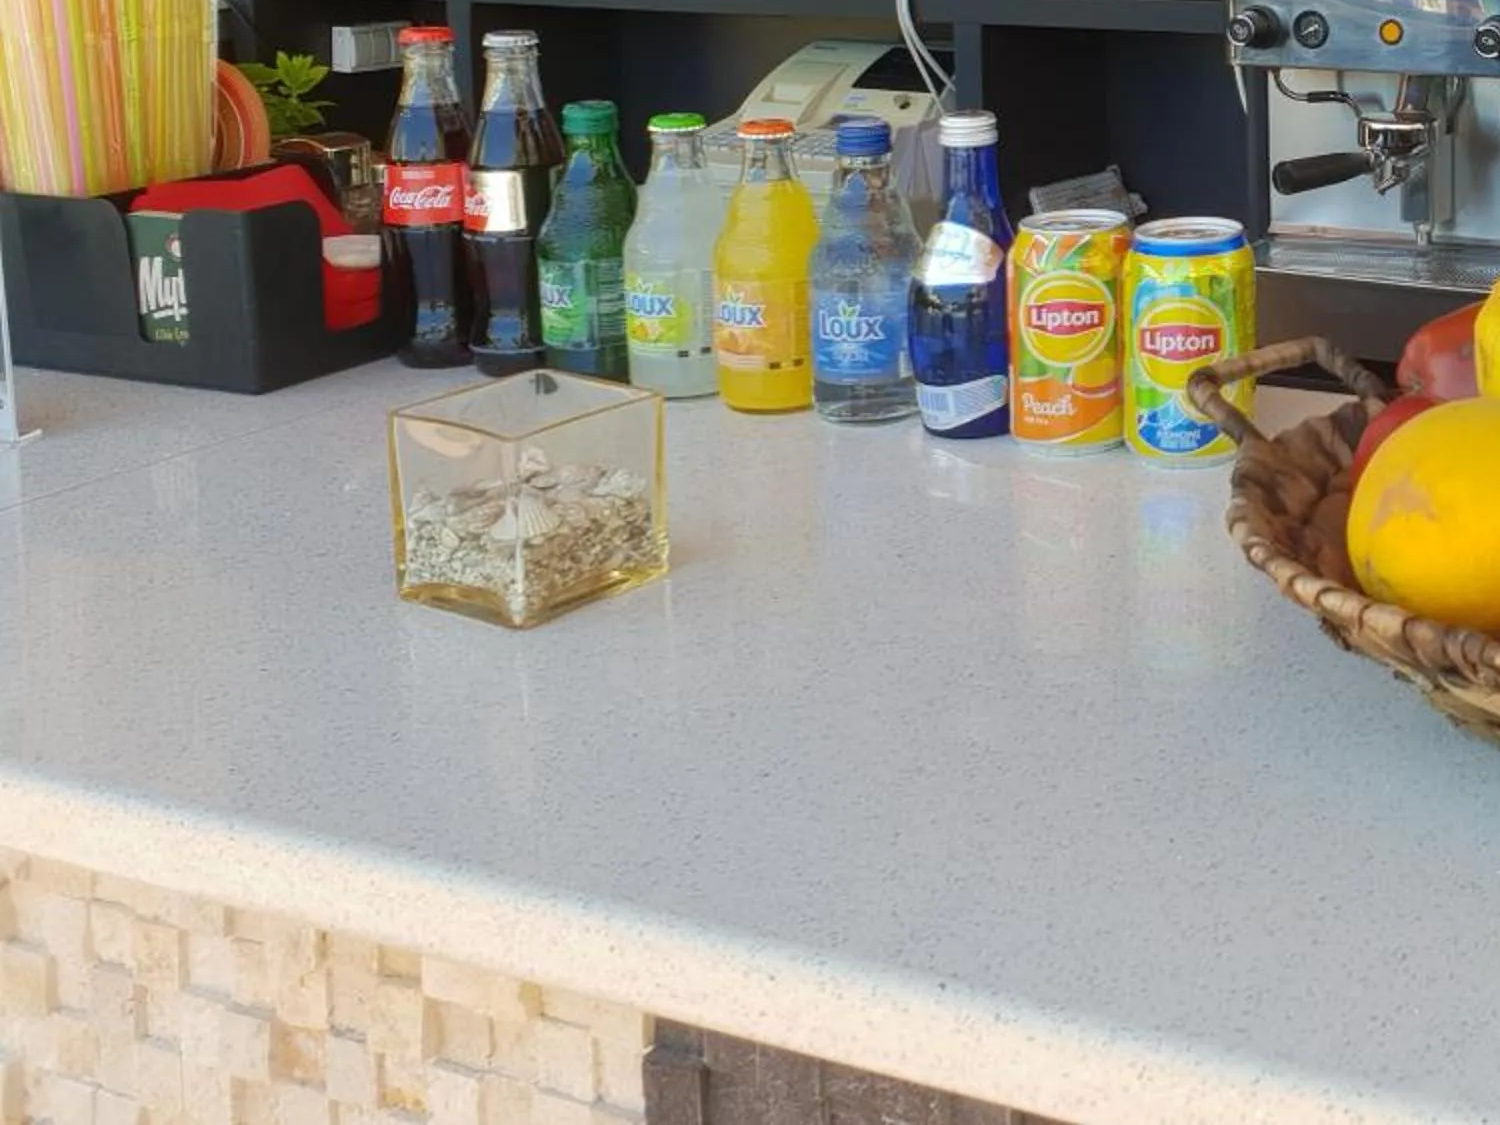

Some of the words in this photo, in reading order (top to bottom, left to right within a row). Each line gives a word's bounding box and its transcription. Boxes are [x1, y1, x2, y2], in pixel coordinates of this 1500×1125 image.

[1031, 307, 1099, 332] Lipton
[1144, 330, 1215, 357] Lipton
[1022, 392, 1078, 416] Peach
